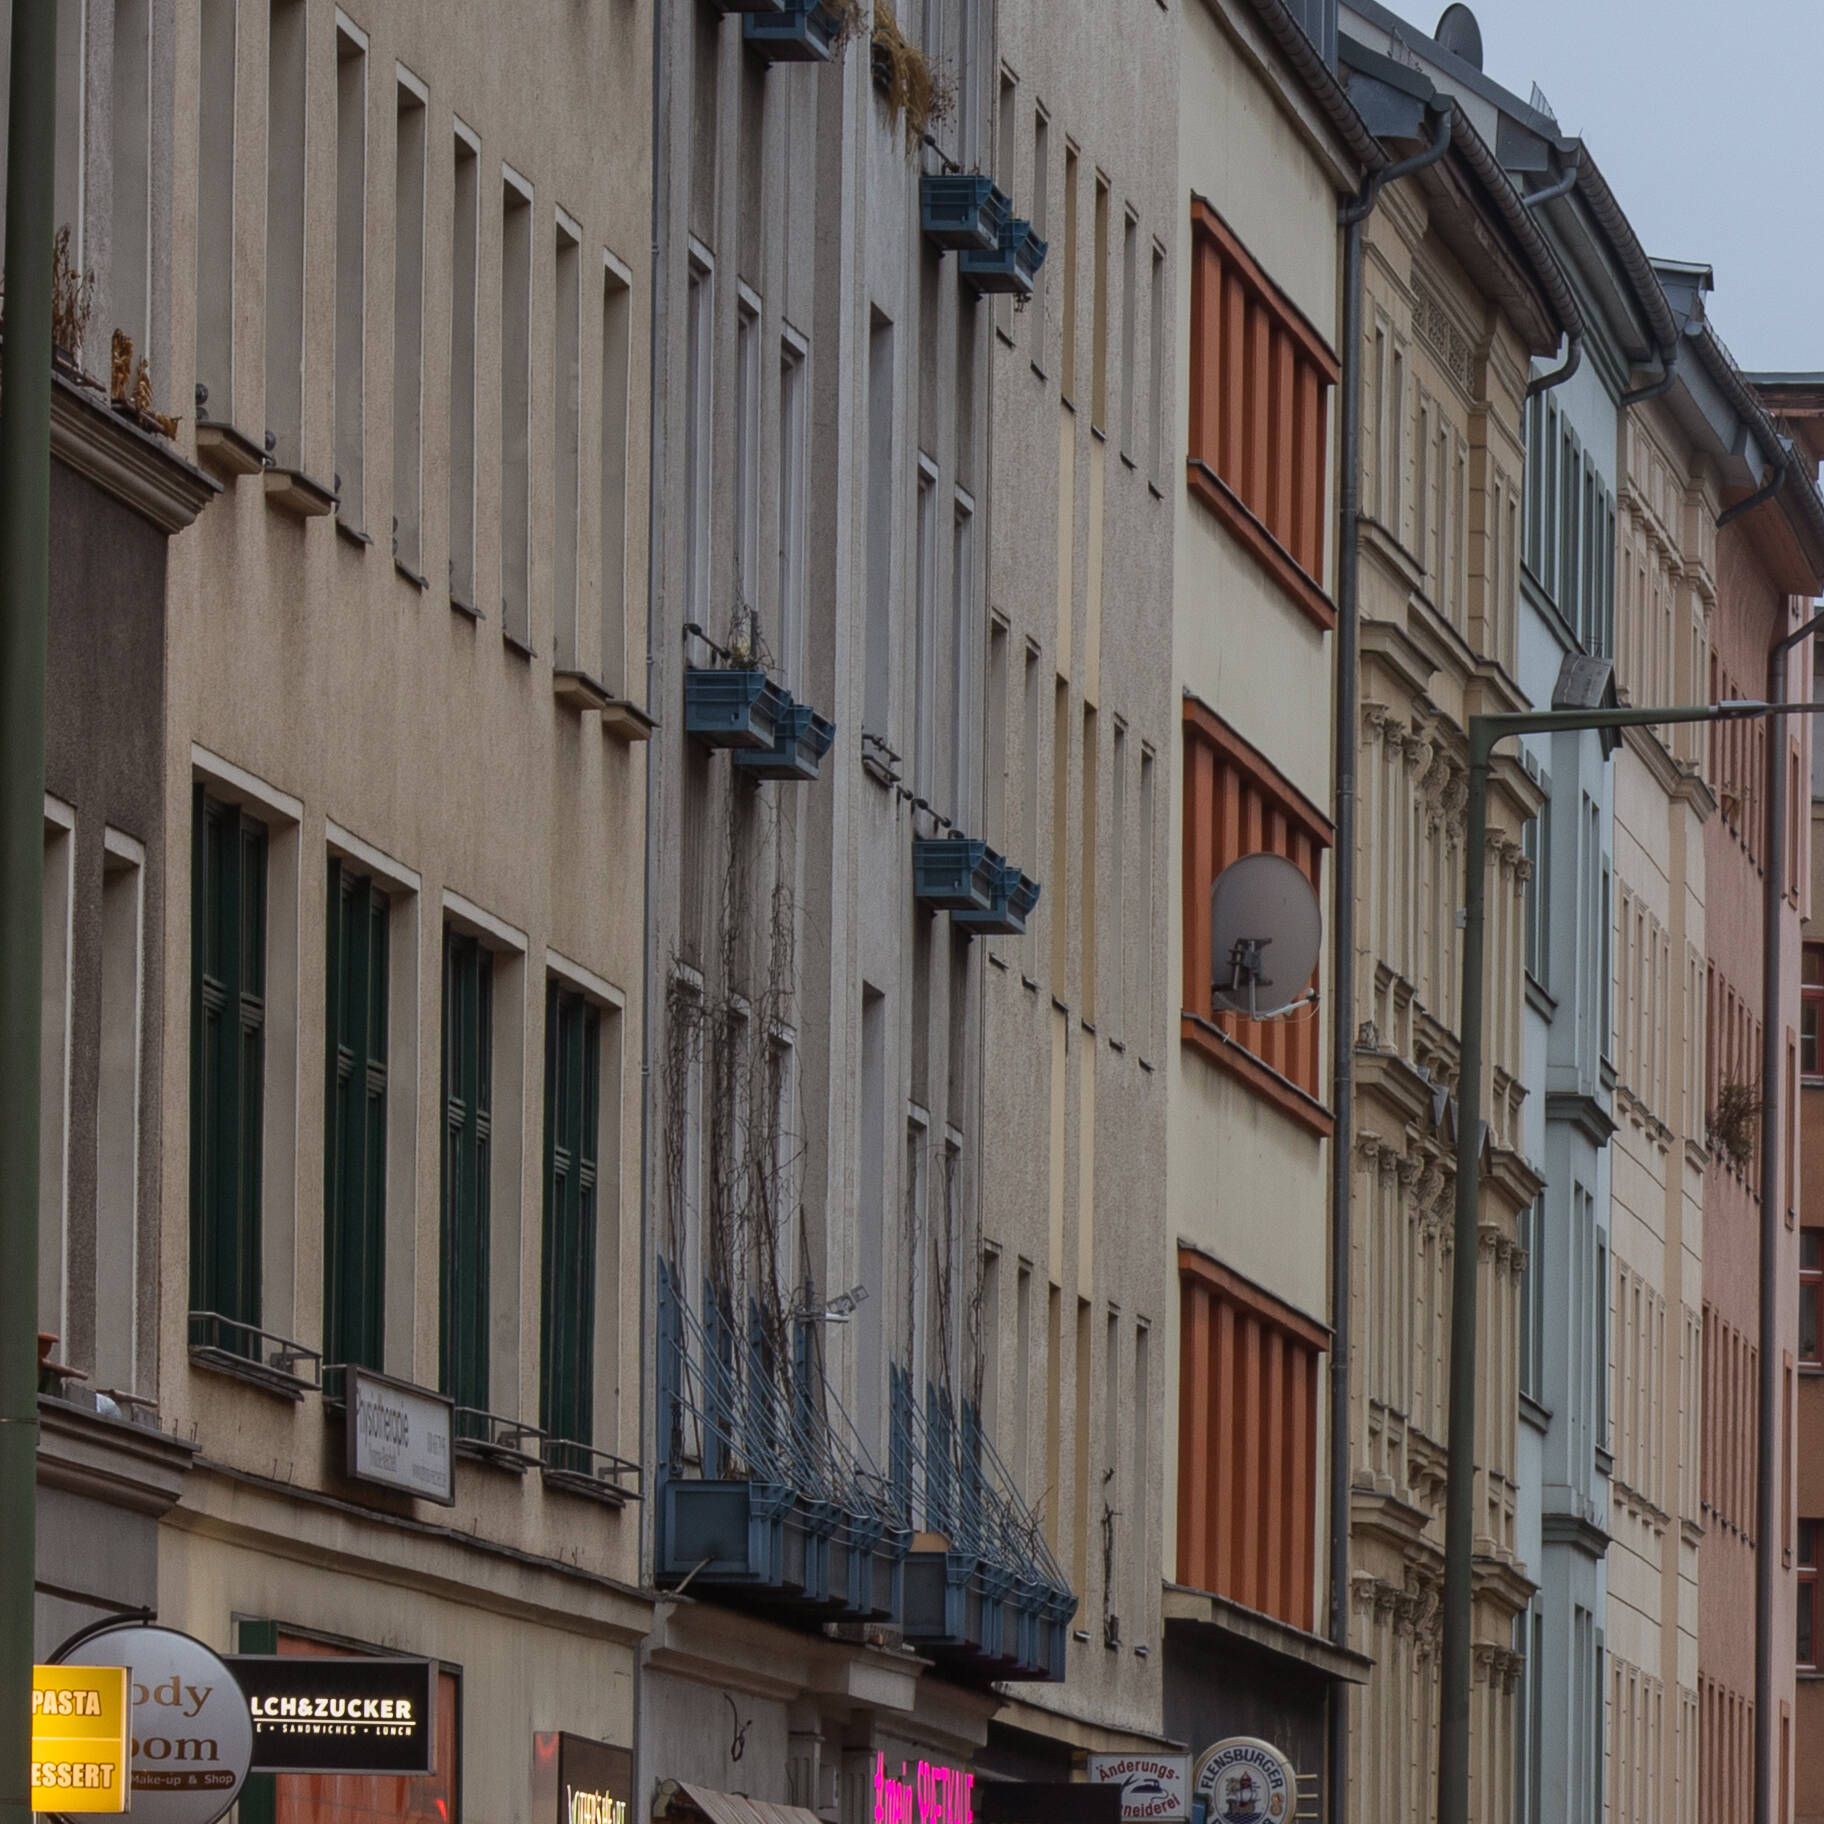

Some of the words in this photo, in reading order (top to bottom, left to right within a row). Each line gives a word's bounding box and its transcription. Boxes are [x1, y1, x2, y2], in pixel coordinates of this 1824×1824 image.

[33, 1690, 101, 1716] PASTA
[133, 1675, 212, 1717] ody
[251, 1696, 411, 1718] LCH&ZUCKER
[282, 1724, 356, 1735] SANDWICHES
[376, 1726, 412, 1736] LUNCH
[132, 1737, 220, 1760] om
[32, 1763, 114, 1789] ESSERT
[189, 1775, 197, 1784] &
[204, 1774, 233, 1785] Shop
[1096, 1761, 1180, 1781] Änderungs-
[1201, 1750, 1284, 1789] FLENSBURGER
[1122, 1796, 1180, 1817] neiderei
